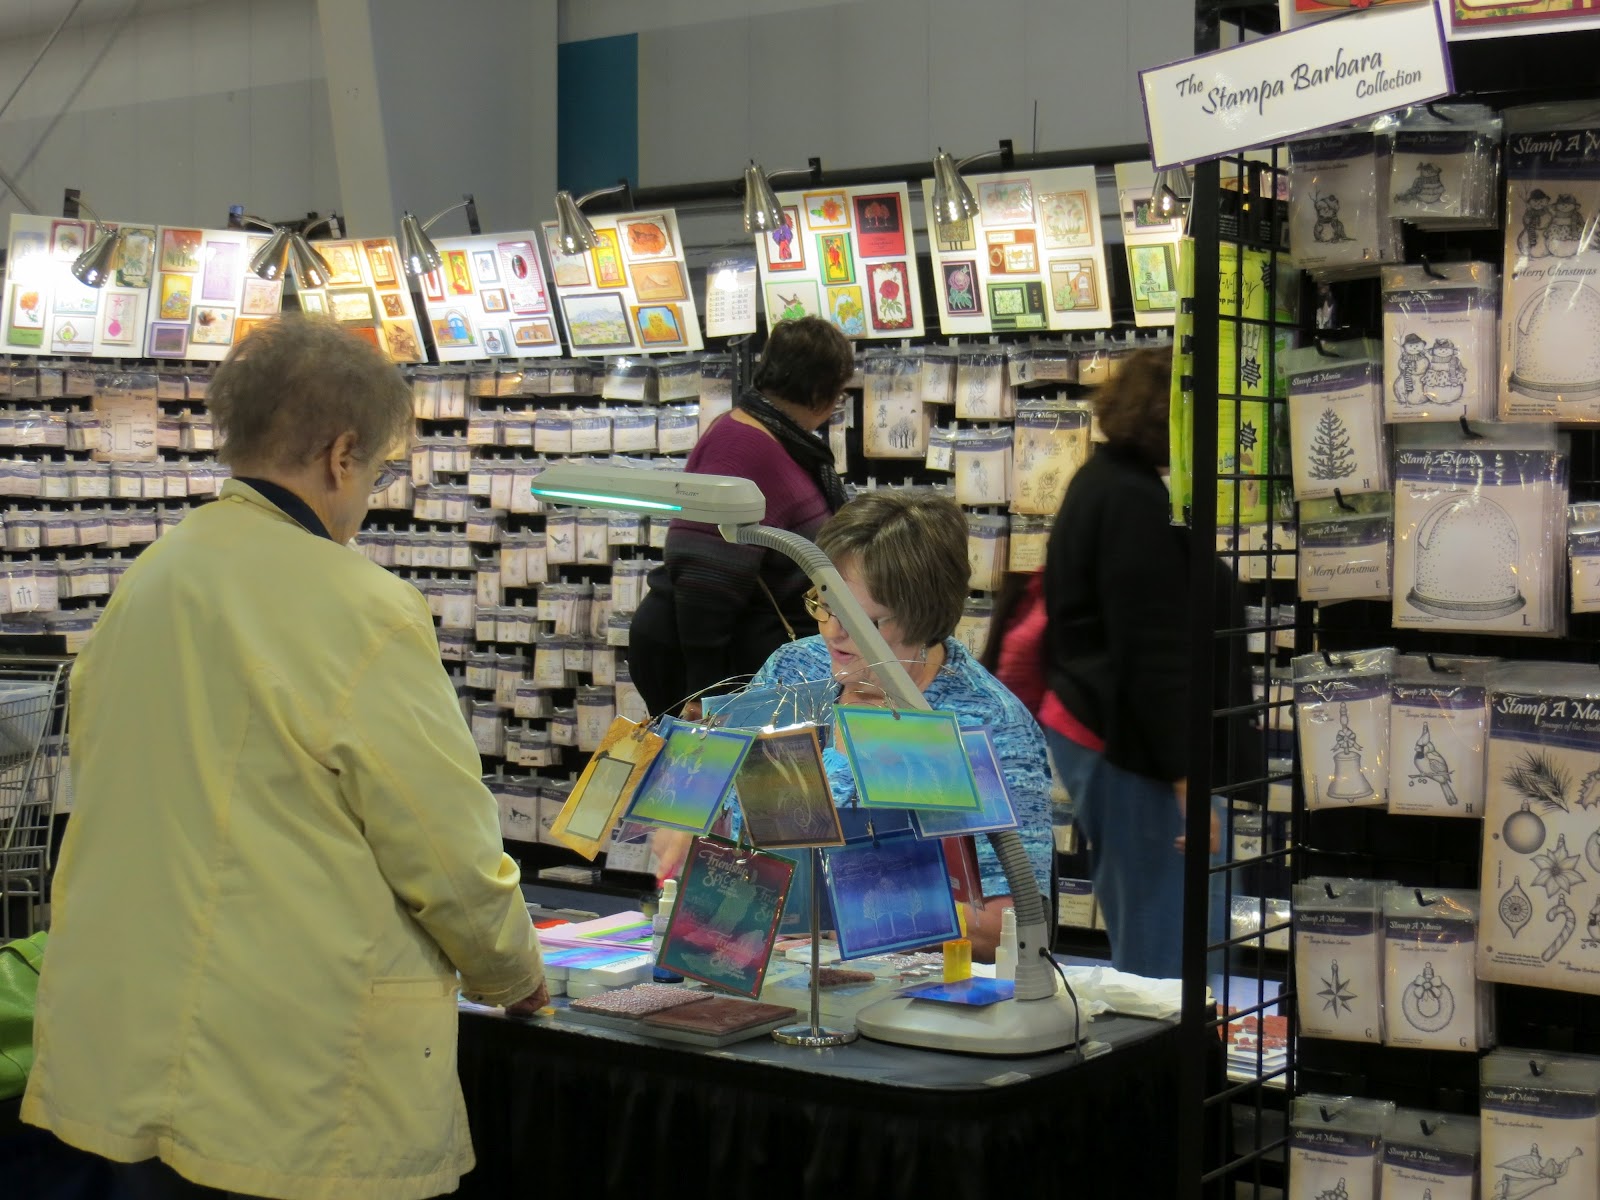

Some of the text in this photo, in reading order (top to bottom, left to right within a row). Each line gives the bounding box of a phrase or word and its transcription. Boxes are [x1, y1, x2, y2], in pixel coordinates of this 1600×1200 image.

[1175, 73, 1204, 98] The
[1201, 48, 1383, 115] Stampa Barbara
[1355, 69, 1422, 99] Collection
[1514, 136, 1563, 161] Stamp
[1565, 134, 1581, 152] A
[1547, 264, 1598, 277] Christmas
[1400, 452, 1432, 470] Stamp
[1362, 478, 1370, 489] H
[1306, 562, 1380, 580] Merry Christmas
[1522, 613, 1530, 627] L
[1497, 696, 1548, 725] Stamp
[1550, 700, 1566, 718] A
[1465, 802, 1473, 814] H
[698, 849, 749, 882] Friendship
[1365, 1027, 1372, 1039] G
[1459, 1036, 1467, 1048] G
